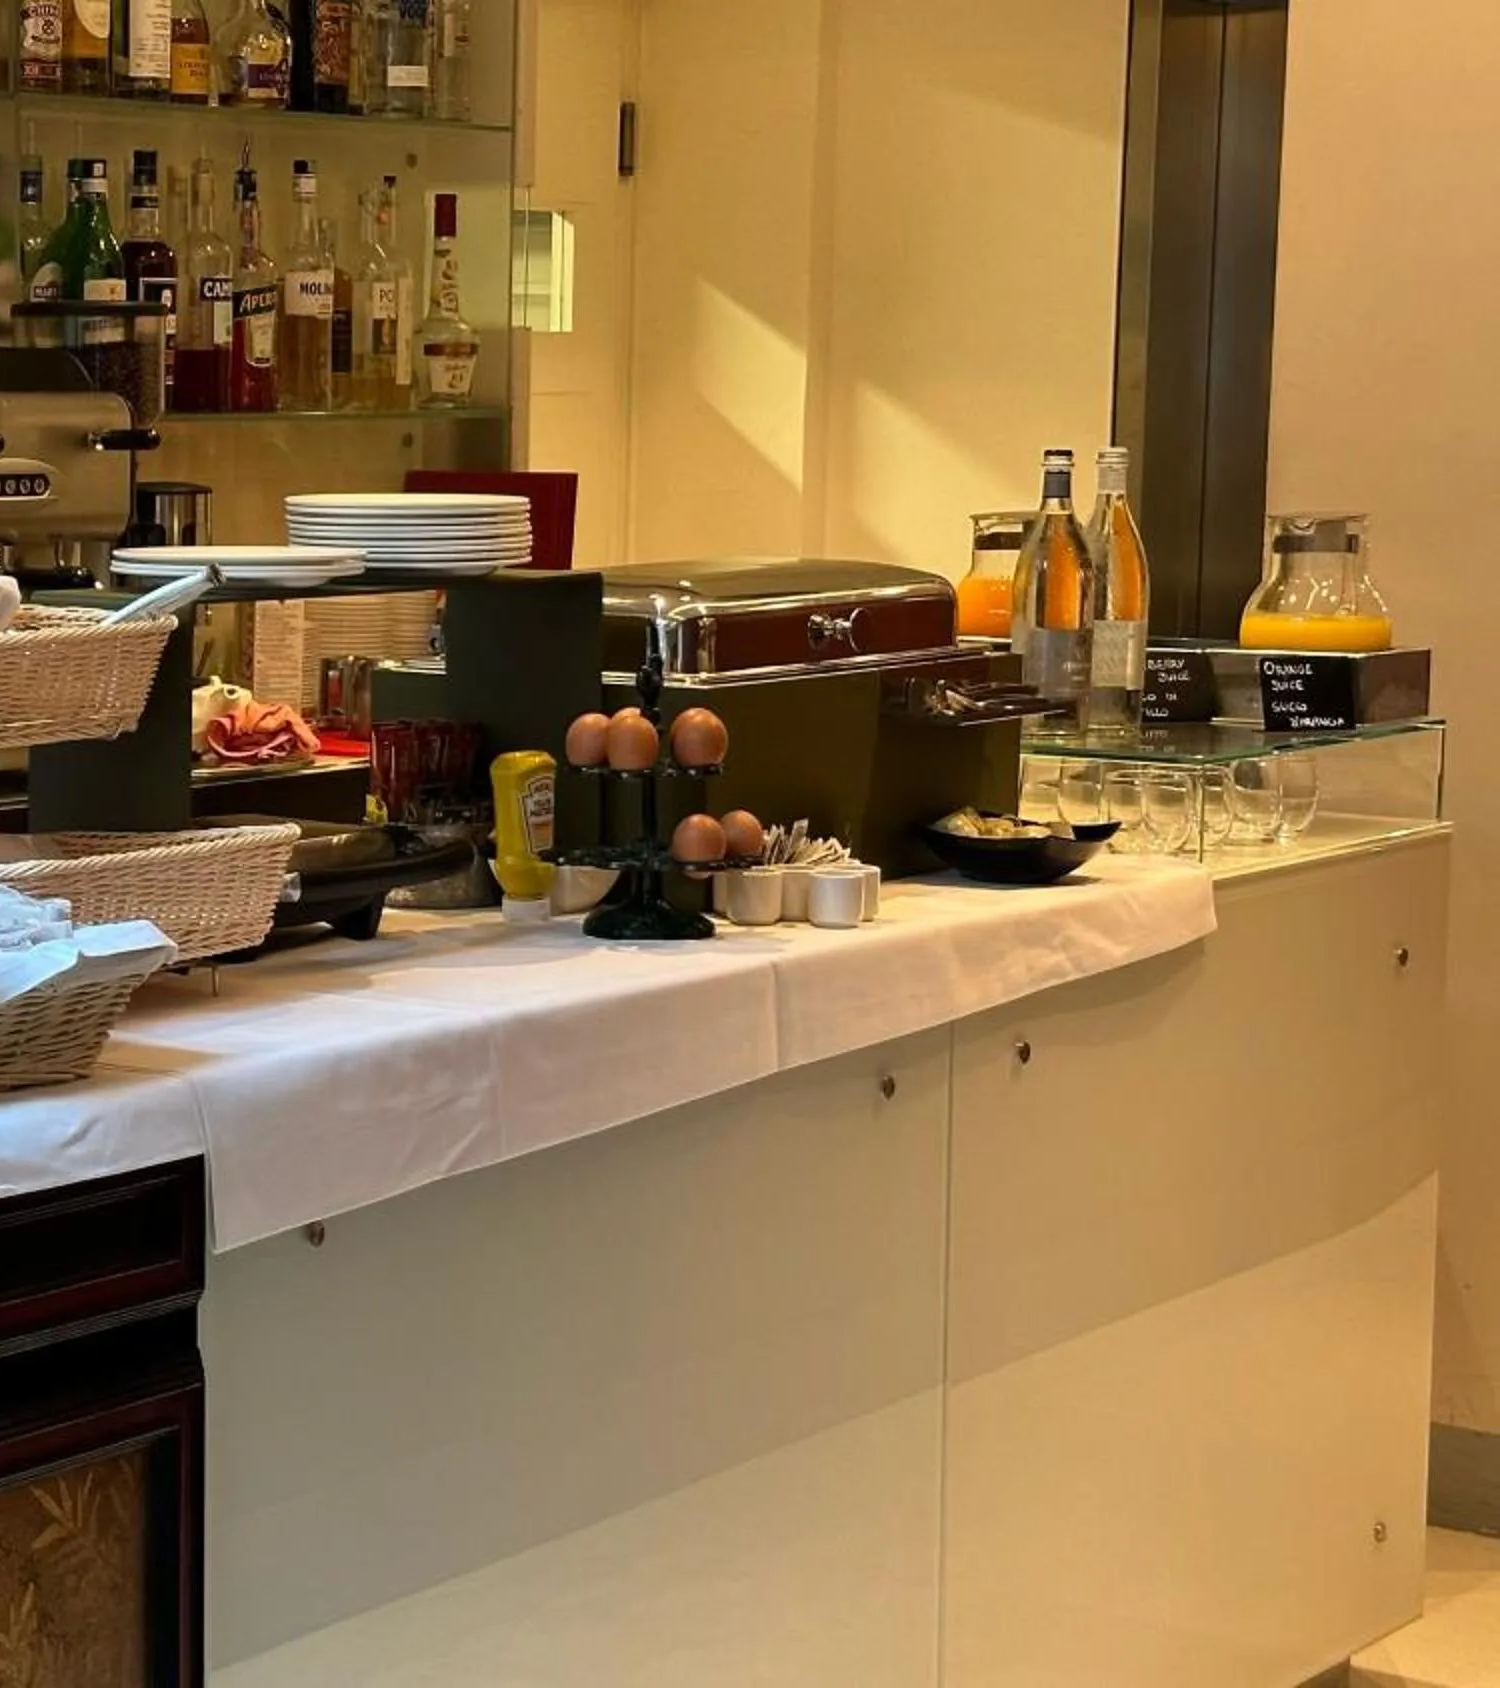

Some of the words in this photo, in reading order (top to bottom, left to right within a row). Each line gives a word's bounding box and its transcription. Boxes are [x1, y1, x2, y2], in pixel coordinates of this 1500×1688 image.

[1263, 661, 1314, 676] ORANGE
[1270, 679, 1305, 692] JUICE
[1270, 701, 1308, 713] SUCCO
